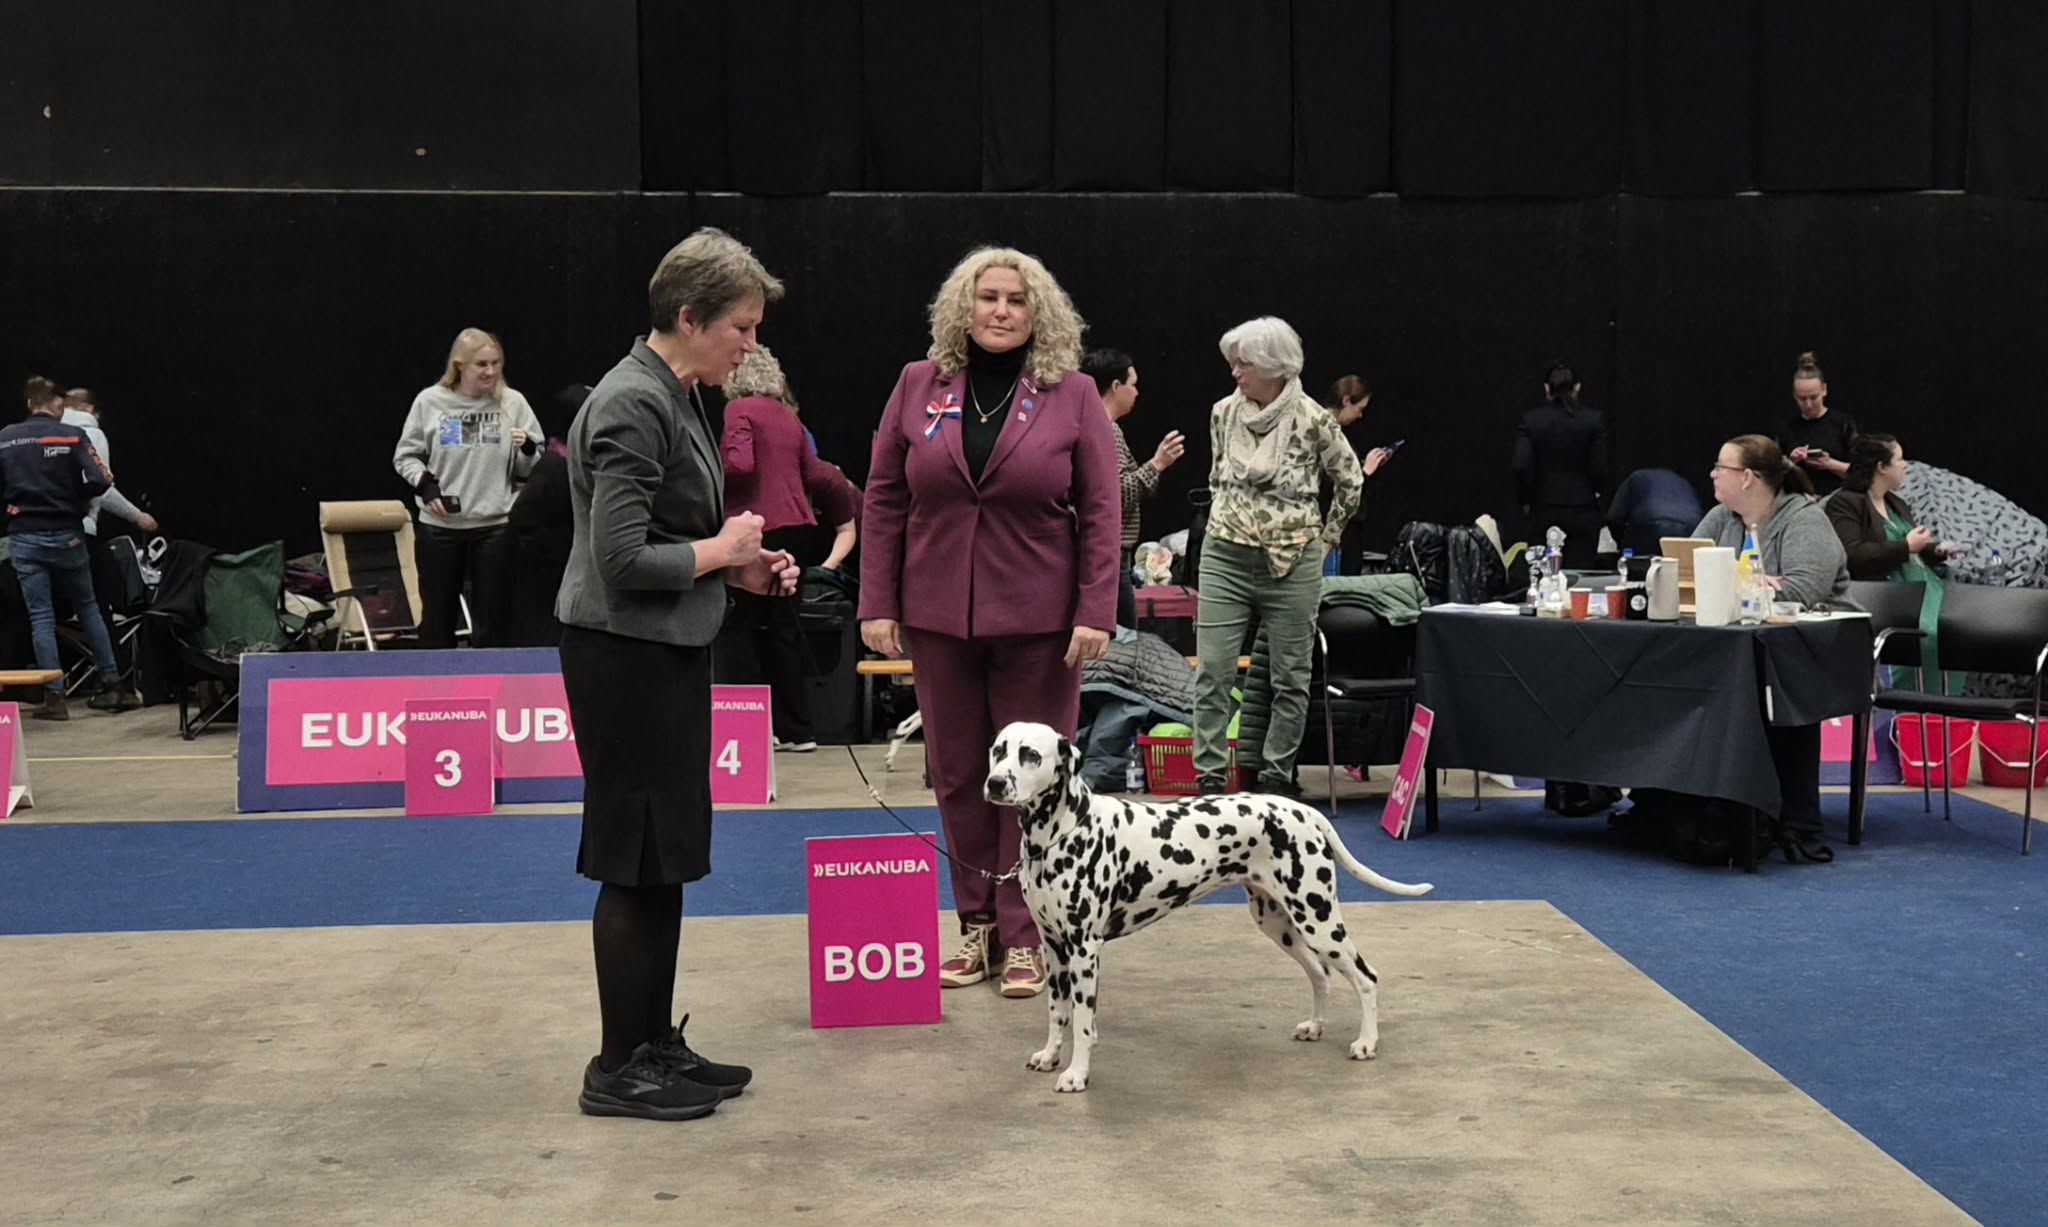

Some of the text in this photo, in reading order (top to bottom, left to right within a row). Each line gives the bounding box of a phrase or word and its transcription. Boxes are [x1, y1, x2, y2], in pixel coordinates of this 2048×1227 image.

[302, 707, 575, 748] EUKUB
[417, 710, 487, 721] EUKANUBA
[434, 749, 462, 787] 3
[716, 739, 742, 775] 4
[824, 859, 931, 877] EUKANUBA
[824, 941, 926, 983] BOB
